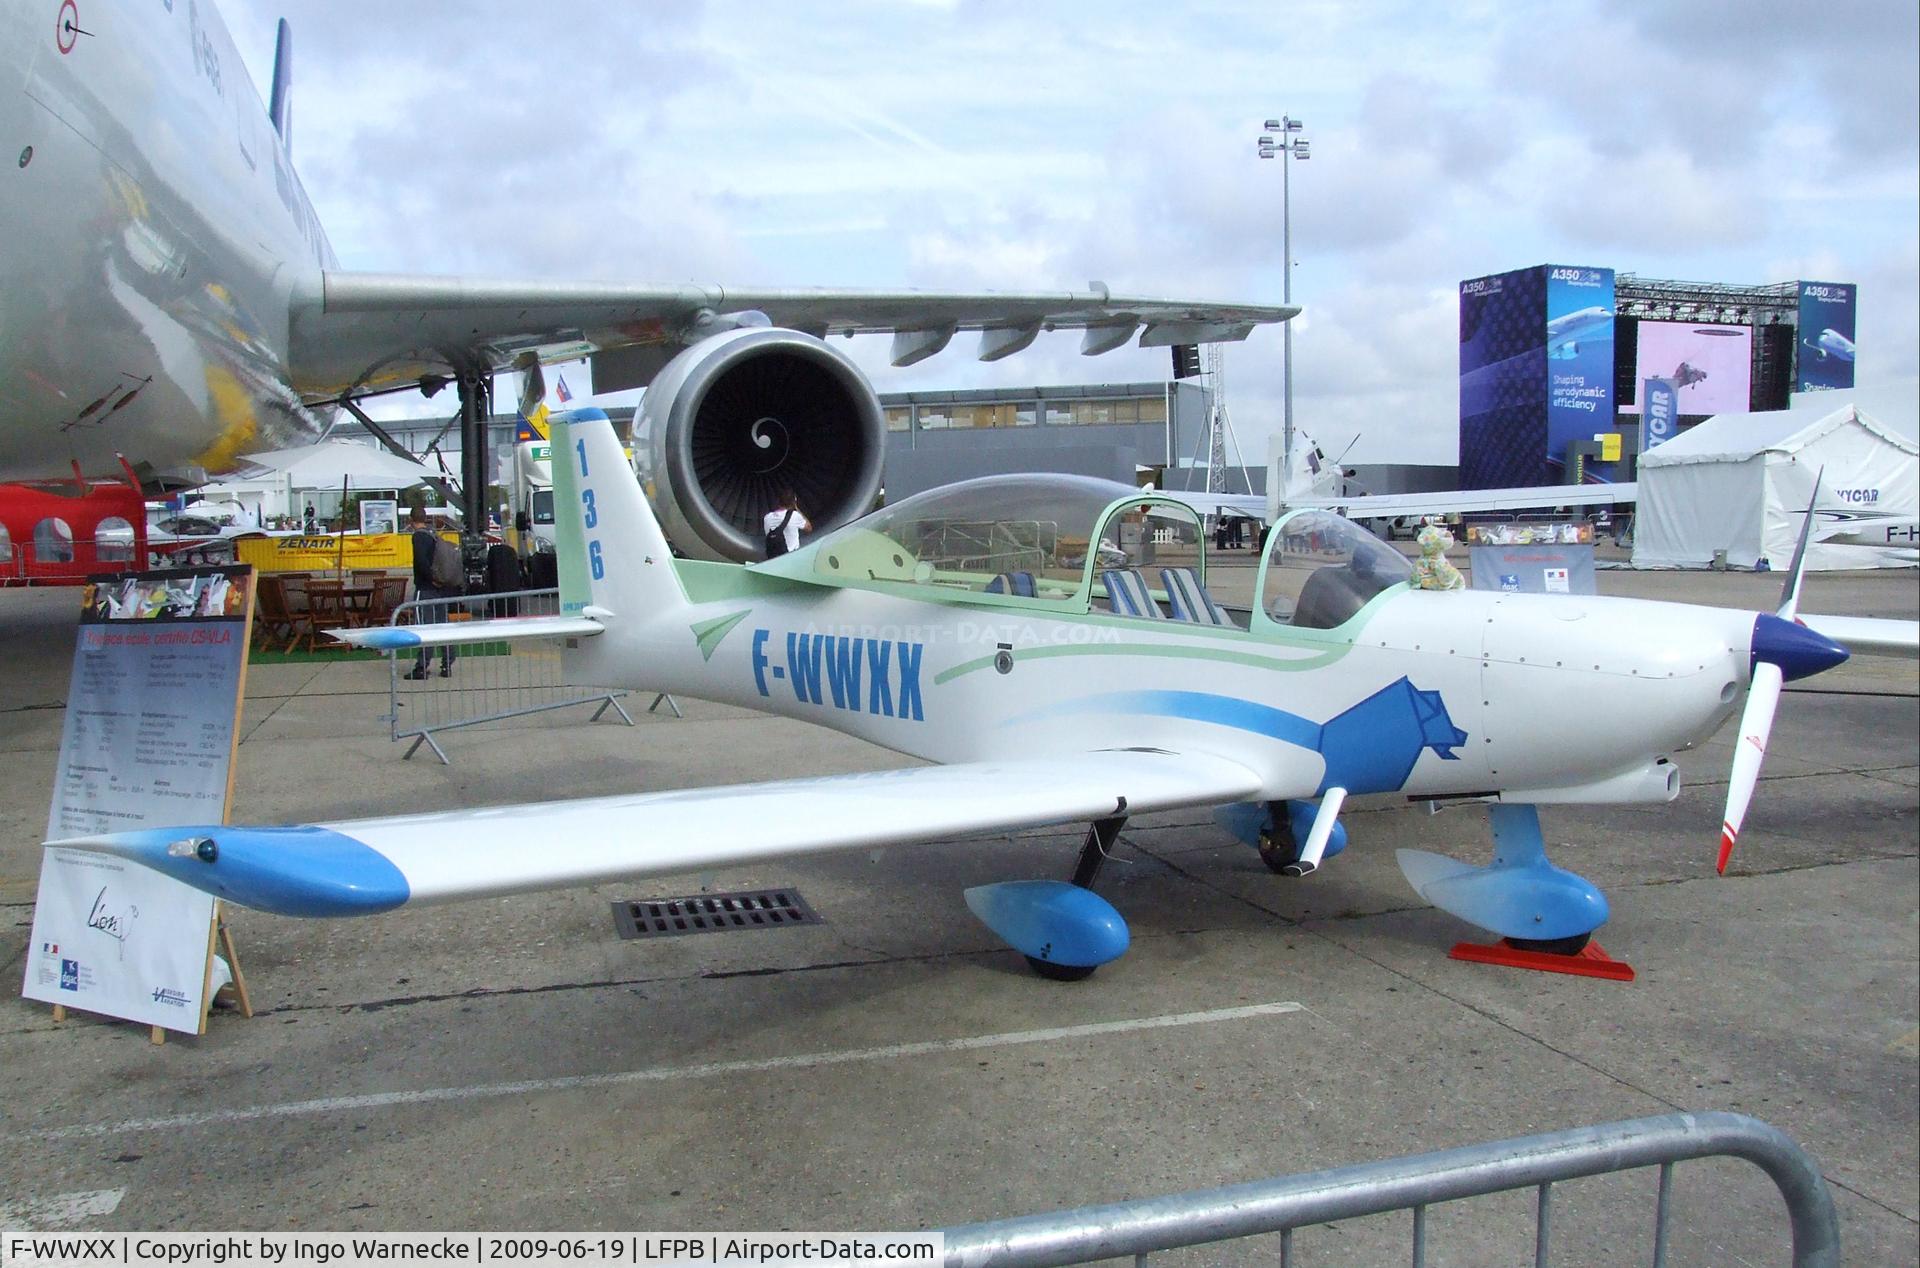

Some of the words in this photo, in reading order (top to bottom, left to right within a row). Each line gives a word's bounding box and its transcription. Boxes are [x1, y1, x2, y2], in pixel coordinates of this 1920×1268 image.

[1552, 269, 1579, 280] A350
[1462, 281, 1484, 294] A350
[1804, 286, 1828, 297] A350
[1553, 375, 1584, 387] Shaping
[1553, 386, 1605, 398] aerodynamic
[1553, 397, 1596, 412] efficiency
[277, 538, 335, 549] ZENAIR
[752, 628, 925, 722] F-WWXX
